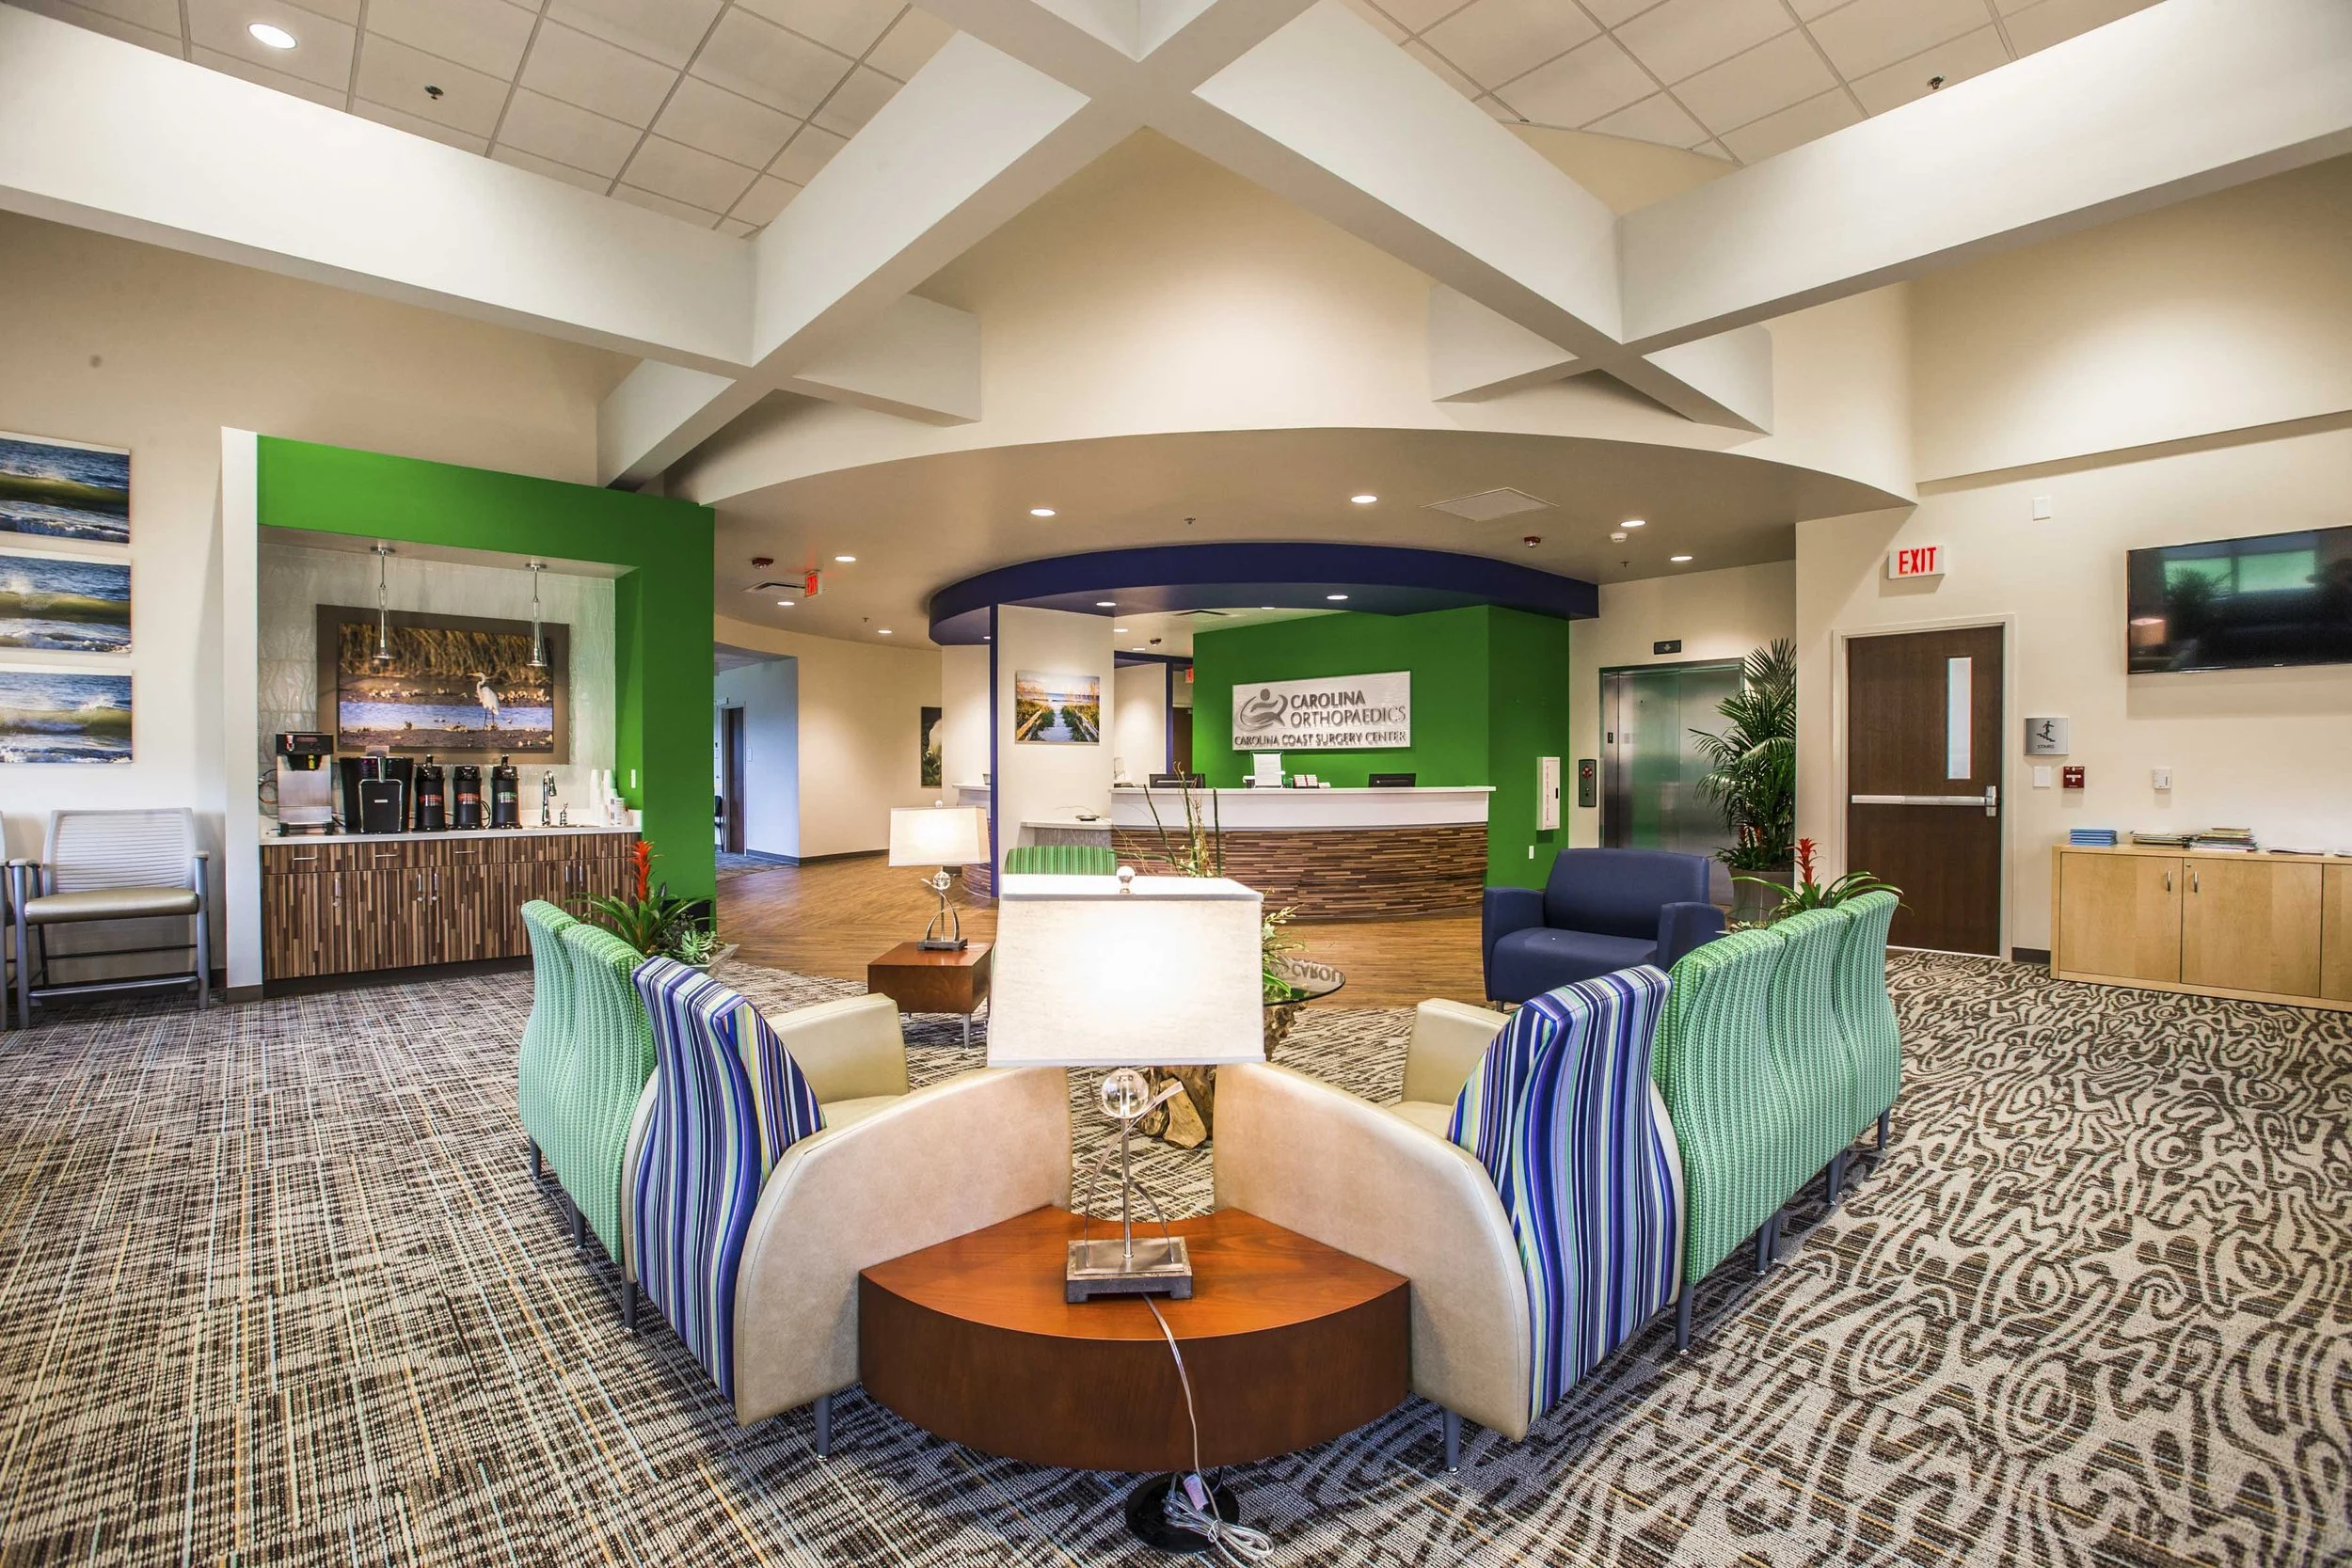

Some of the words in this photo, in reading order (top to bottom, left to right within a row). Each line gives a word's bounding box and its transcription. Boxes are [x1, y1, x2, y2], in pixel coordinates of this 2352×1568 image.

[1899, 546, 1937, 575] EXIT
[1290, 689, 1366, 709] CAROLINA
[1290, 705, 1406, 728] ORTHOPAEDICS
[1234, 736, 1280, 746] CAROLINA
[1282, 734, 1314, 747] COAST
[1315, 732, 1362, 746] SURGERY
[1365, 730, 1406, 744] CENTER
